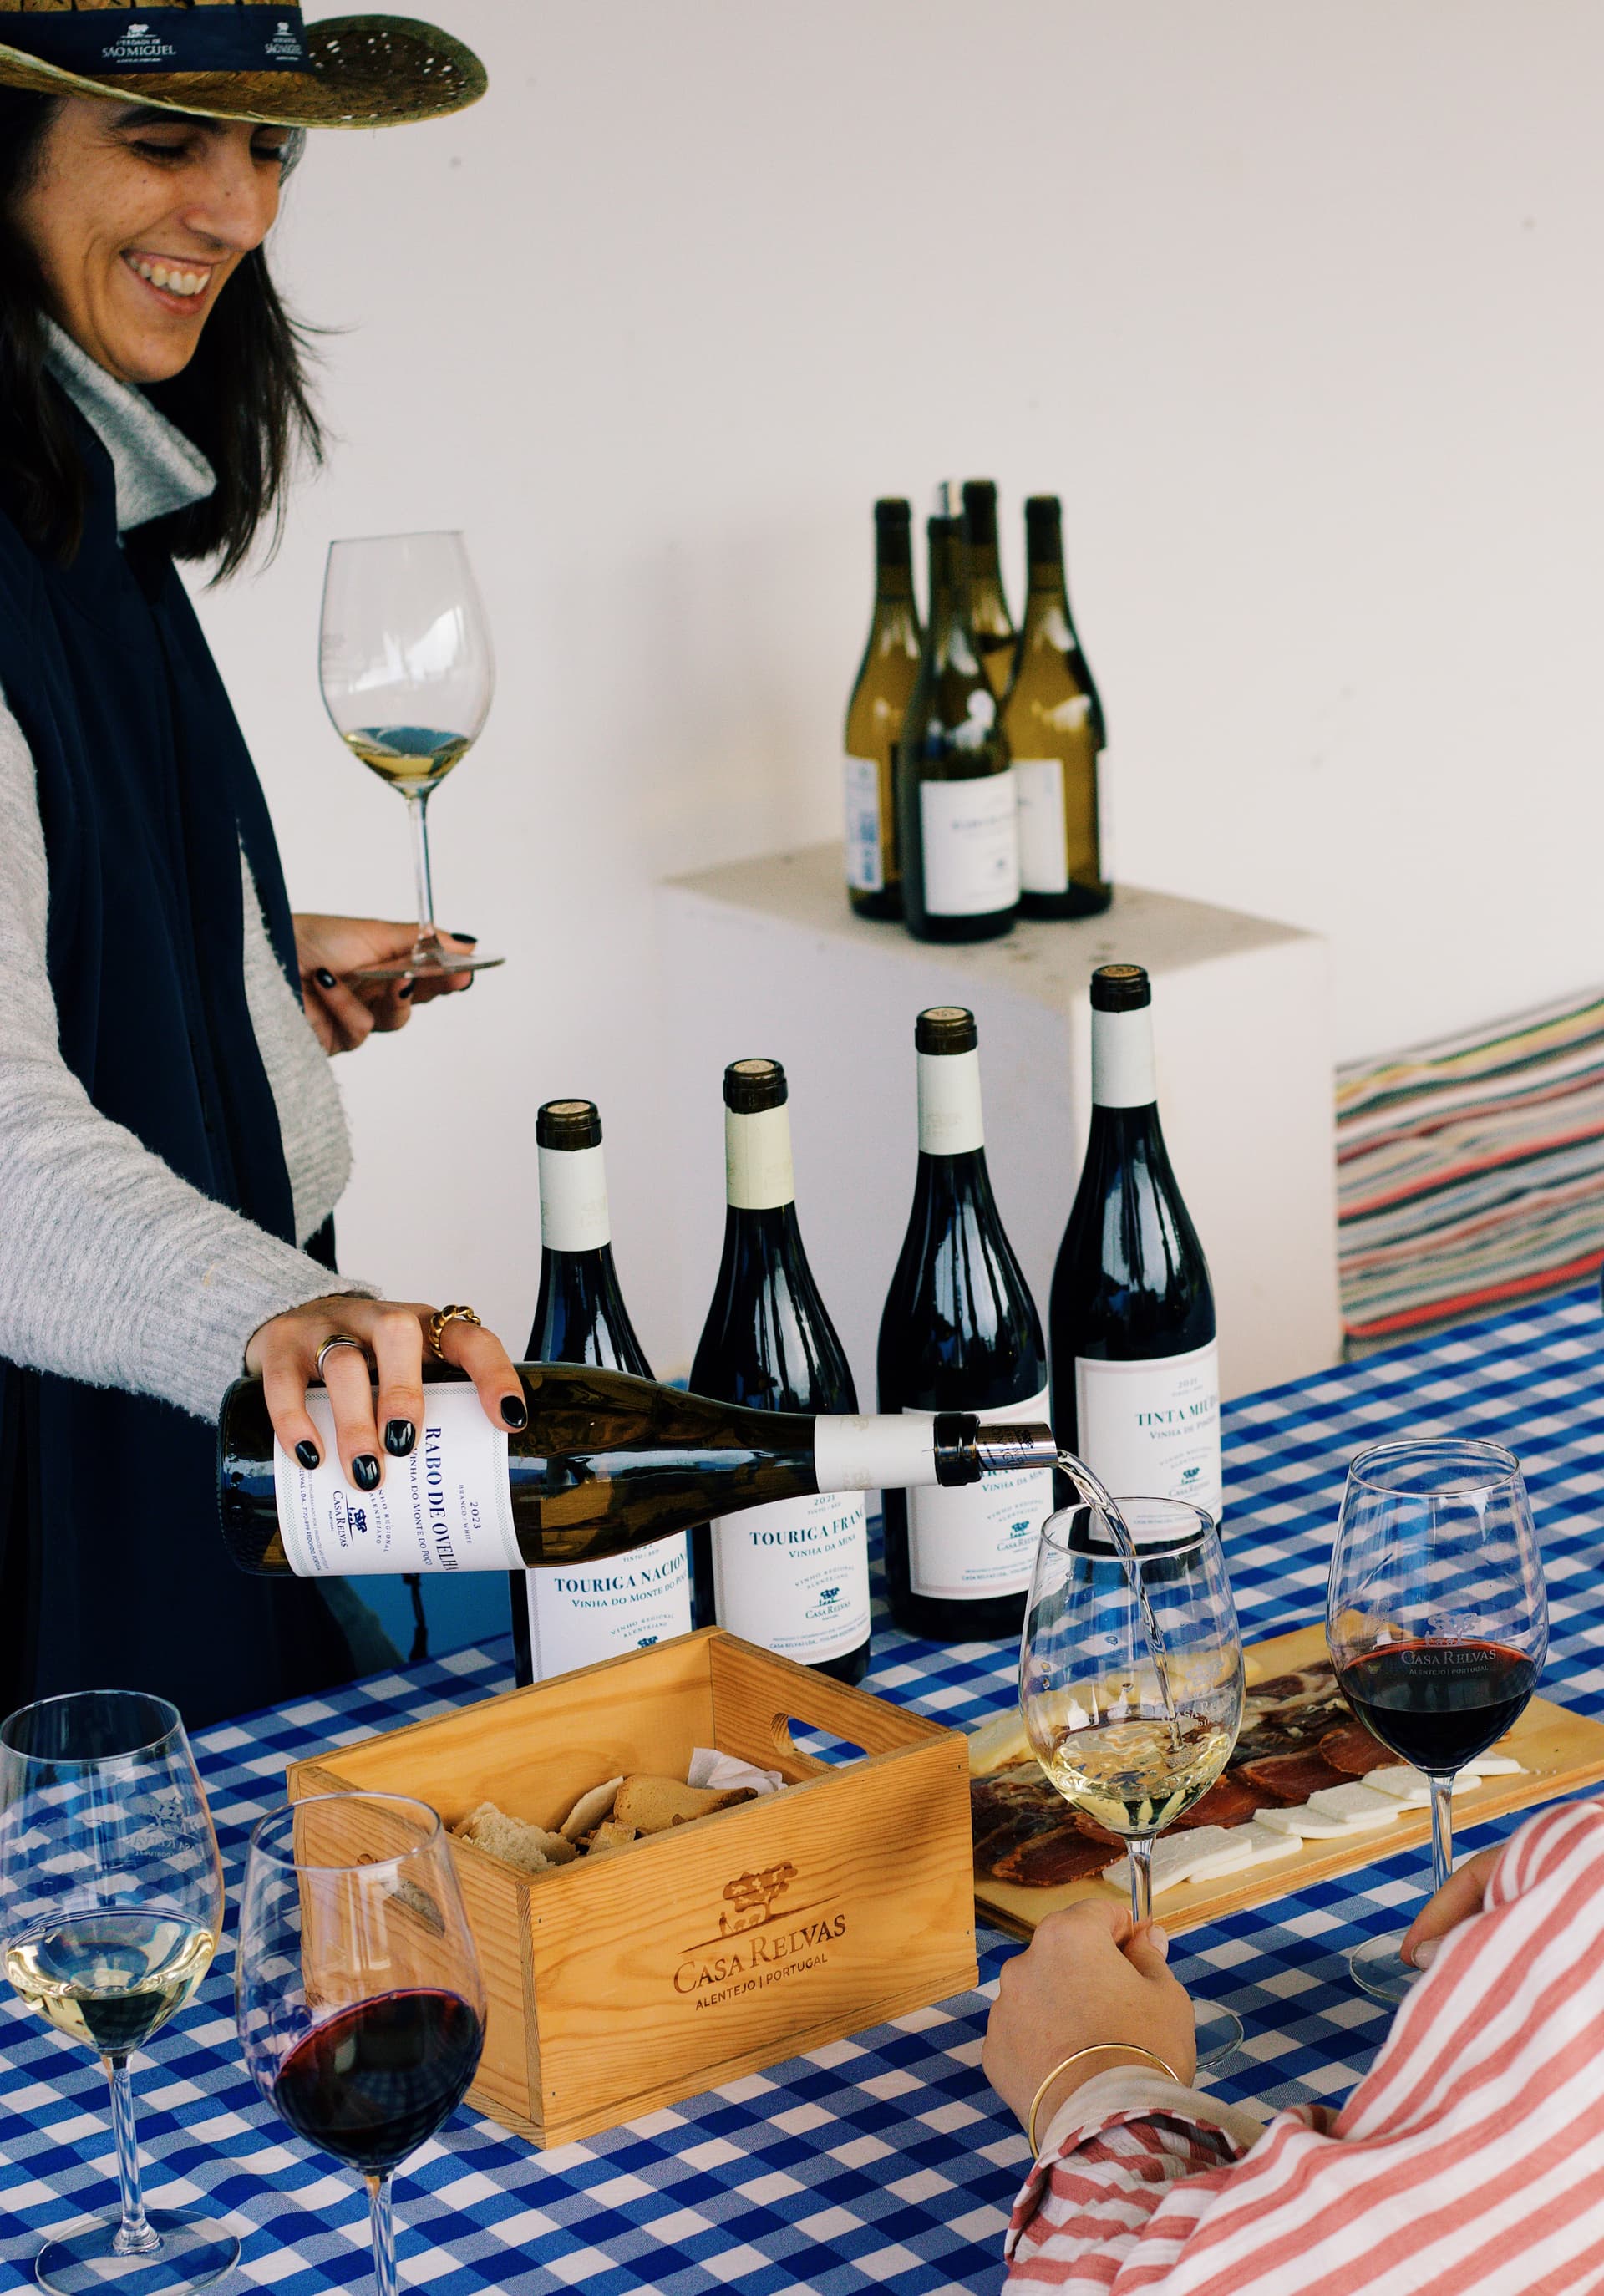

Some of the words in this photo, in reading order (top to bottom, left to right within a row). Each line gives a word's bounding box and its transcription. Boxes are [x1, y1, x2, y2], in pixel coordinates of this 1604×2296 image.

[126, 44, 177, 56] MIGUEL
[1135, 1408, 1185, 1425] TINTA
[425, 1427, 442, 1486] RABO
[411, 1486, 419, 1501] DO
[982, 1481, 1013, 1491] VINHA
[333, 1491, 343, 1516] CASA
[428, 1491, 446, 1518] DE
[459, 1484, 467, 1517] BRANCO
[815, 1494, 835, 1506] 2021
[413, 1503, 424, 1536] MONTE
[470, 1501, 481, 1529] 2023
[336, 1517, 348, 1548] RELVAS
[383, 1513, 392, 1553] REGIONAL
[749, 1525, 828, 1546] TOURIGA
[418, 1537, 427, 1549] DO
[789, 1547, 822, 1558] VINHA
[825, 1543, 836, 1552] DA
[554, 1575, 636, 1592] TOURIGA
[571, 1599, 608, 1608] VINHA
[612, 1597, 627, 1606] DO
[629, 1586, 662, 1603] MONTE
[805, 1610, 826, 1619] CASA
[611, 1621, 638, 1635] VINHO
[1401, 1650, 1441, 1665] CASA
[1443, 1649, 1496, 1665] RELVAS
[1451, 1665, 1489, 1674] PORTUGAL
[673, 1953, 745, 1994] CASA
[748, 1914, 847, 1968] RELVAS
[695, 1979, 756, 2011] ALENTEJO
[766, 1953, 828, 1985] PORTUGAL
